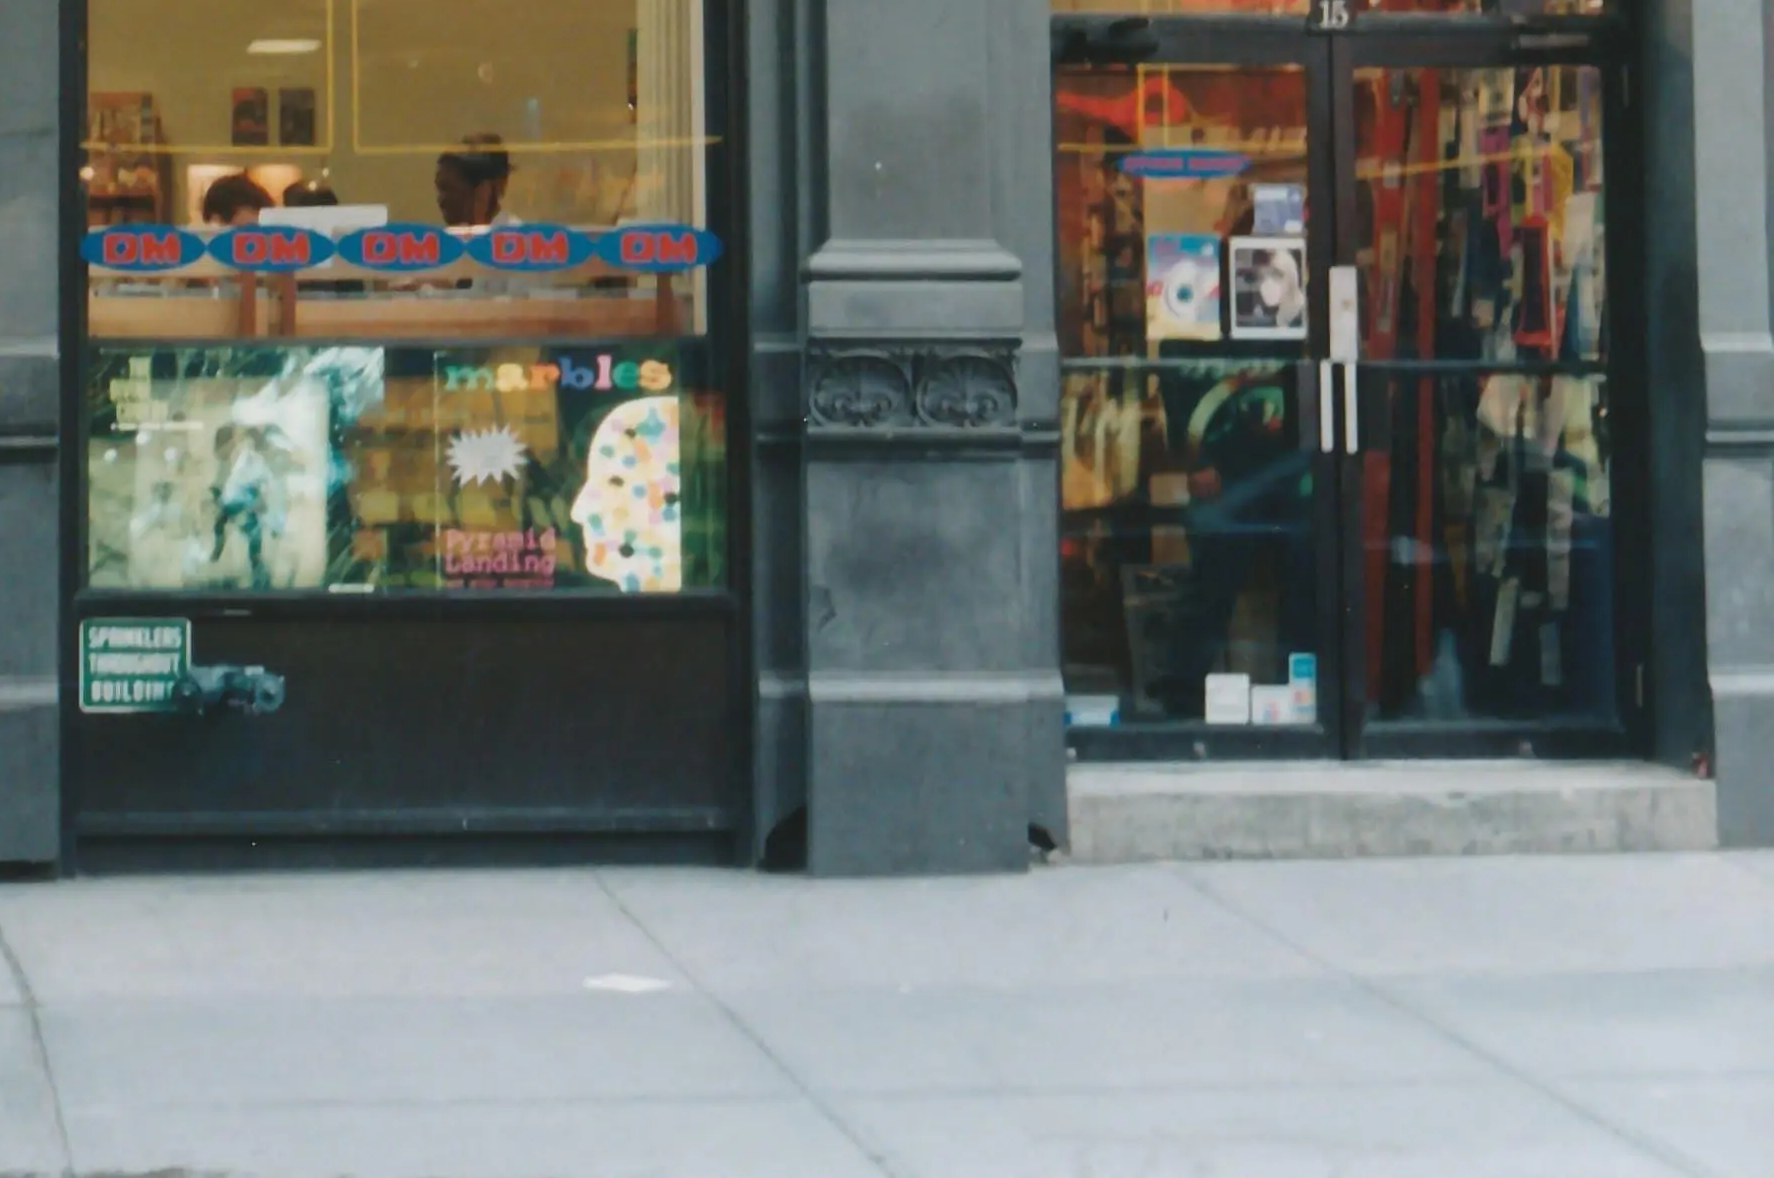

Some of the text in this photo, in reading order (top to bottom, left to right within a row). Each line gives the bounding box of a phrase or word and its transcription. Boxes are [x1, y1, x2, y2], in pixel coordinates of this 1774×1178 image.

[103, 232, 698, 265] OM OM OM OM OM
[444, 354, 672, 393] marbles
[445, 551, 556, 578] Landing
